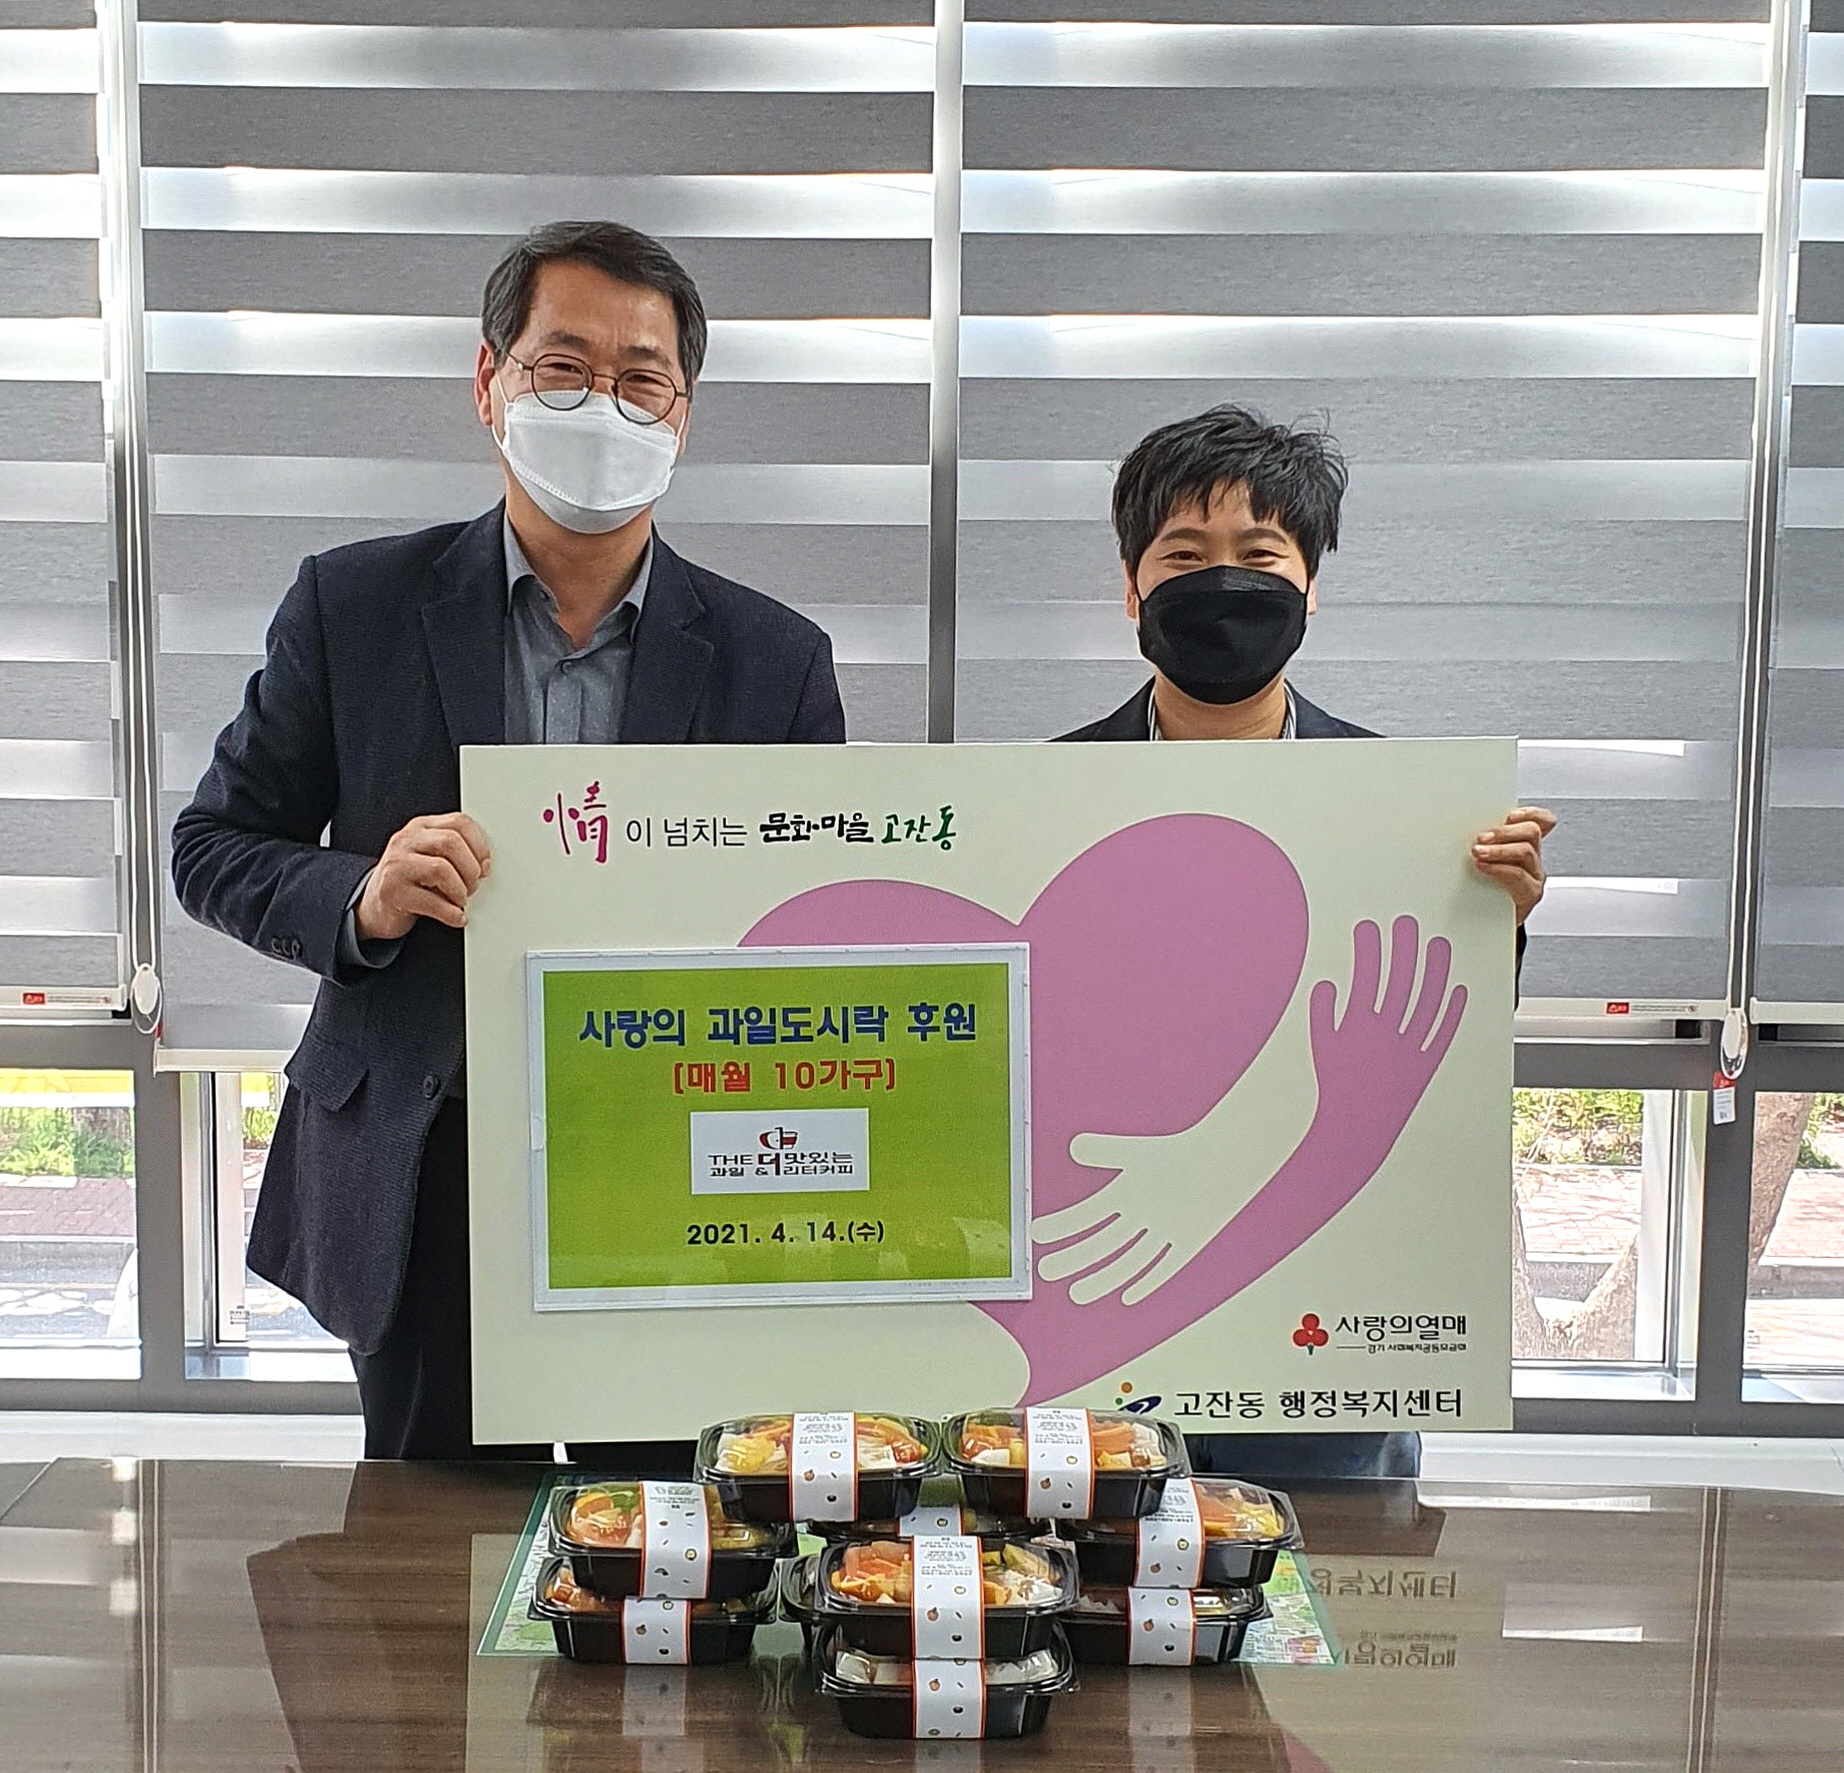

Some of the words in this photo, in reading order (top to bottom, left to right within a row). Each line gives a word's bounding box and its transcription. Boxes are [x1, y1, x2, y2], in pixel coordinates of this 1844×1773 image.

[543, 780, 608, 863] 情
[626, 817, 651, 847] 이
[664, 816, 748, 847] 넘치는
[881, 804, 957, 850] 고잔동
[579, 1008, 686, 1050] 사랑의
[707, 1005, 890, 1046] 과일도시락
[907, 1001, 976, 1042] 후원
[708, 1154, 753, 1166] THE
[709, 1166, 745, 1177] 과일
[755, 1167, 769, 1177] &
[783, 1164, 854, 1176] 리터커피
[686, 1223, 761, 1246] 2021.
[770, 1222, 795, 1245] 4.
[806, 1219, 885, 1244] 14.(수)
[1335, 1315, 1467, 1342] 사랑의열매
[1174, 1391, 1266, 1419] 고잔동
[1278, 1388, 1463, 1419] 행정복지센터
